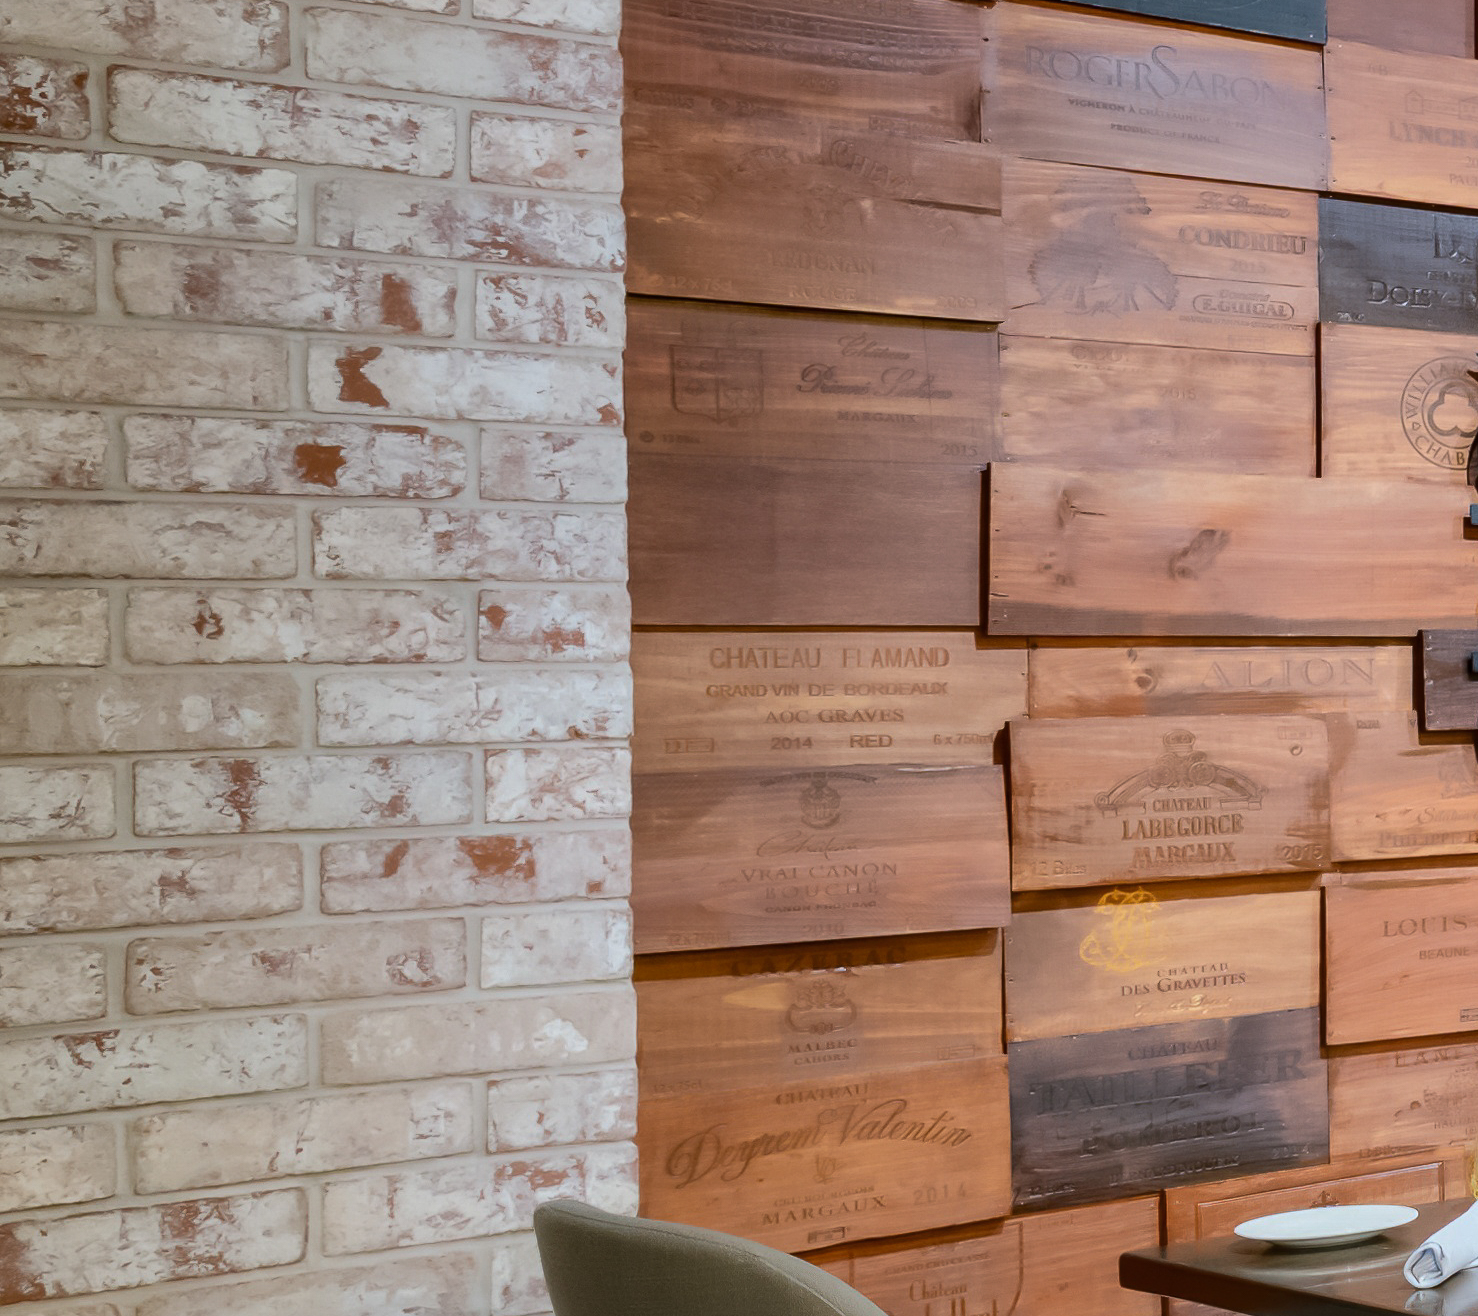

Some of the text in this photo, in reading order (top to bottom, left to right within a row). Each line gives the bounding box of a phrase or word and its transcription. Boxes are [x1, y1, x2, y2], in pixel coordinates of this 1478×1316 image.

[1388, 119, 1467, 148] LYNCH
[1179, 224, 1307, 255] CONDRIEU
[940, 442, 978, 458] 2015
[1413, 435, 1468, 466] CHAB
[709, 646, 951, 670] CHATEAU FLAMAND
[1201, 657, 1375, 688] ALION
[705, 682, 949, 698] GRAND VIN DE BORDEAUX
[765, 708, 905, 725] AOC GRAVES
[770, 736, 813, 751] 2014
[849, 734, 893, 749] RED
[1152, 796, 1213, 813] CHATEAU
[1121, 813, 1245, 841] LABEGORCE
[1130, 841, 1237, 872] MARGAUX
[1281, 843, 1326, 863] 2015
[741, 862, 898, 884] VRAI CANON
[1382, 914, 1469, 939] LOUIS
[1418, 945, 1471, 961] BEAUNE
[1120, 971, 1248, 997] DES GRAVETTES
[788, 1038, 858, 1055] MALBEC
[793, 1051, 851, 1066] CAHORS
[834, 1098, 973, 1147] Valentin
[760, 1183, 968, 1226] MARGAUX 2014
